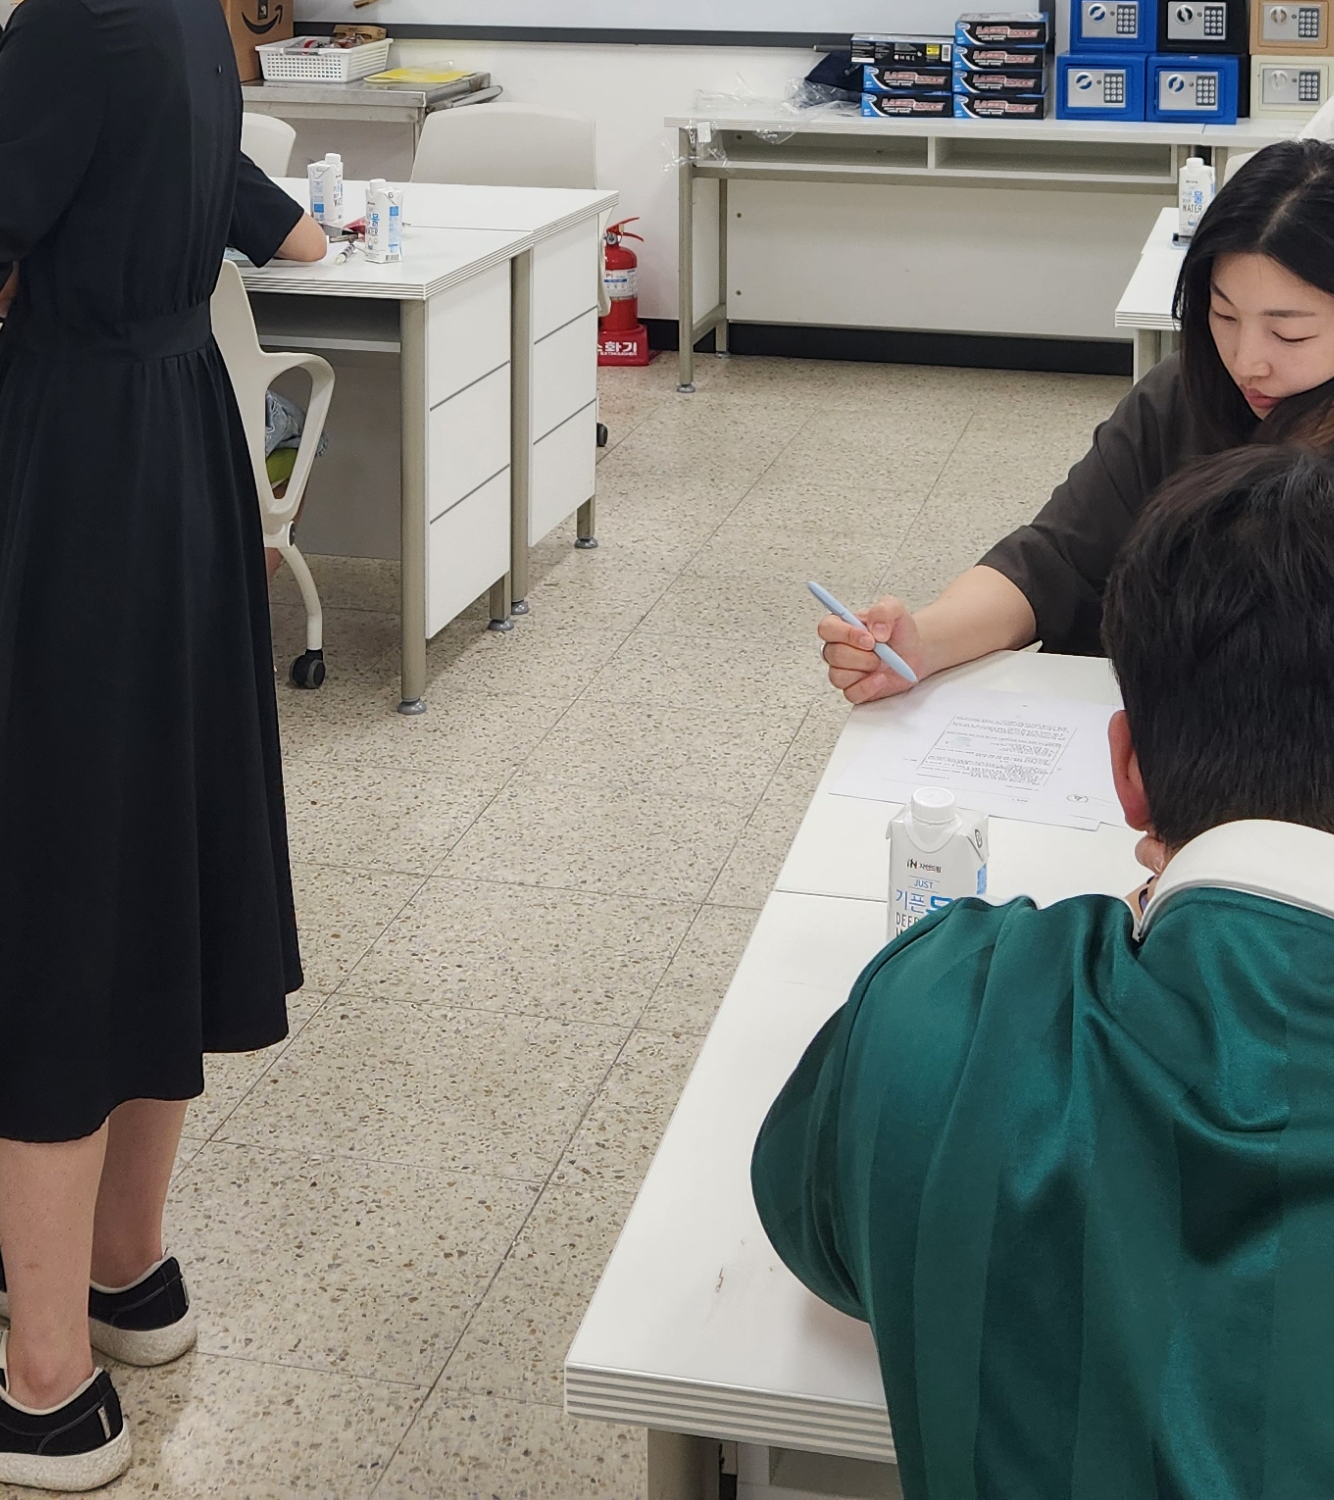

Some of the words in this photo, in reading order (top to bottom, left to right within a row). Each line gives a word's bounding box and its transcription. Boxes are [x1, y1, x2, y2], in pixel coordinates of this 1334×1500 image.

[1182, 203, 1203, 214] WATER
[913, 879, 934, 890] JUST
[895, 889, 927, 915] 기픈
